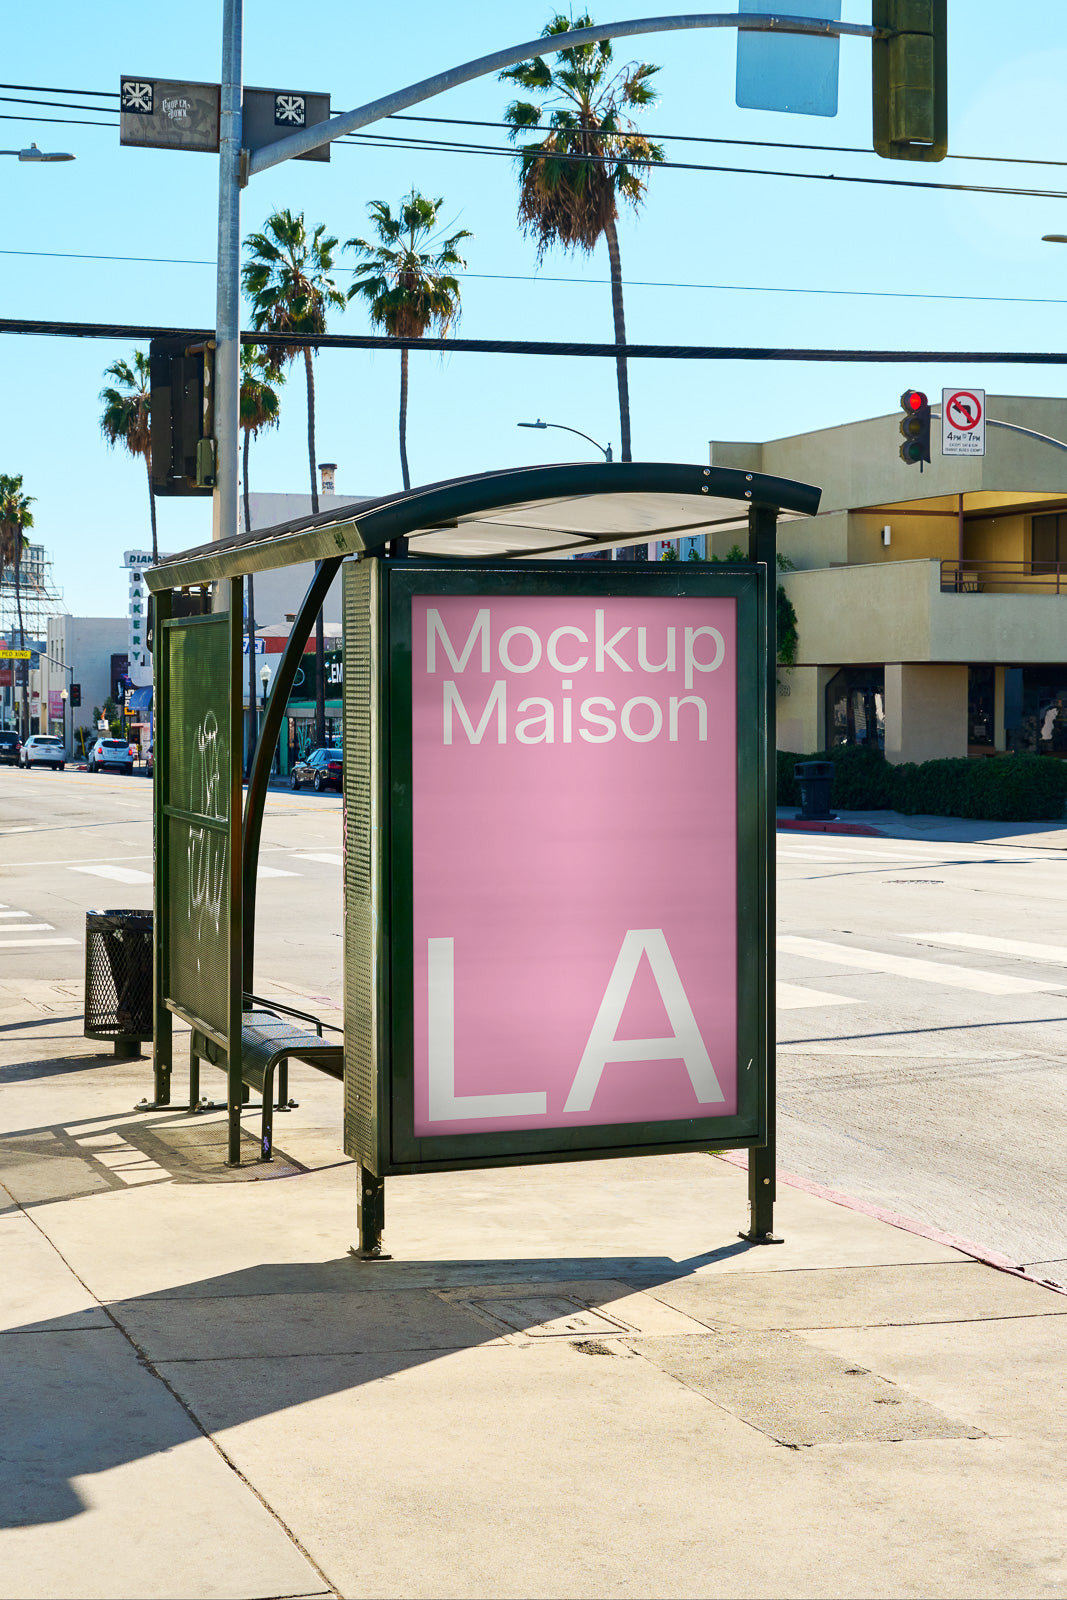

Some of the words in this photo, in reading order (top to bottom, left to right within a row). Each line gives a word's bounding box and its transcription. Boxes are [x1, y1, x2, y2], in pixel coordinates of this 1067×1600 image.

[133, 573, 141, 661] BAKERY
[427, 609, 725, 689] Mockup
[443, 680, 708, 745] Maison
[428, 929, 726, 1121] LA
